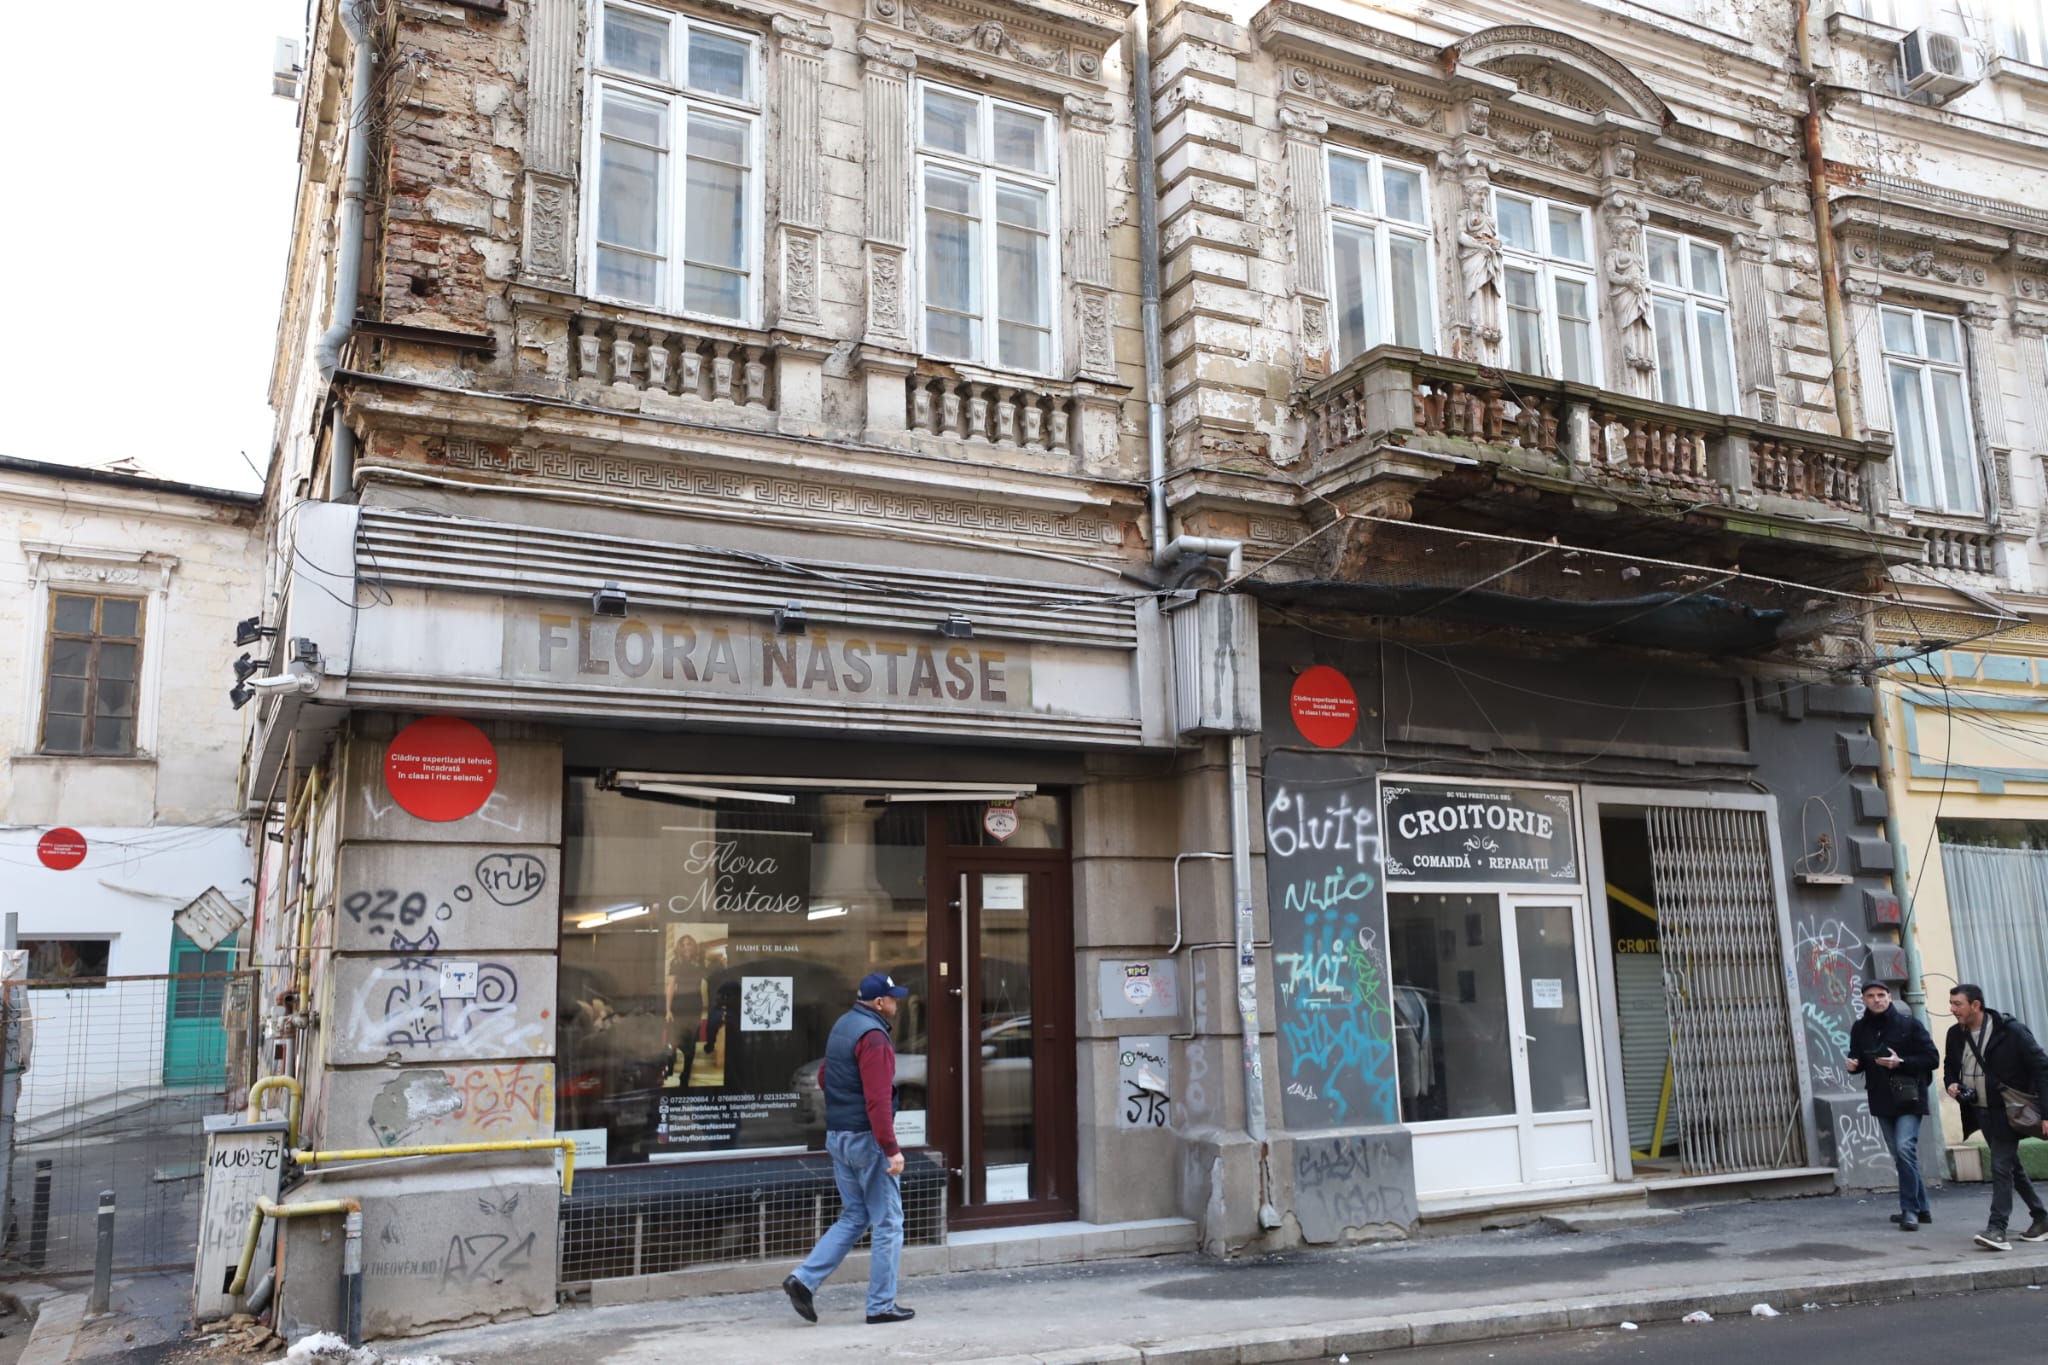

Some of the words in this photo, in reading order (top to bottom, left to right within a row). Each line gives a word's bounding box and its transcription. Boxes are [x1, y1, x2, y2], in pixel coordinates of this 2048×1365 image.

[538, 614, 741, 684] FLORA
[761, 628, 1007, 703] NĂSTASE
[391, 754, 420, 762] Clădire
[422, 755, 465, 764] expertizată
[467, 757, 492, 765] tehnic
[408, 772, 430, 780] clasa
[436, 773, 451, 781] risc
[453, 774, 484, 782] seismic
[1399, 803, 1553, 840] CROITORIE
[684, 840, 779, 874] Flora
[1413, 854, 1471, 869] COMANDĂ
[668, 875, 802, 914] Năstase
[735, 944, 759, 952] HAINE
[761, 944, 773, 952] DE
